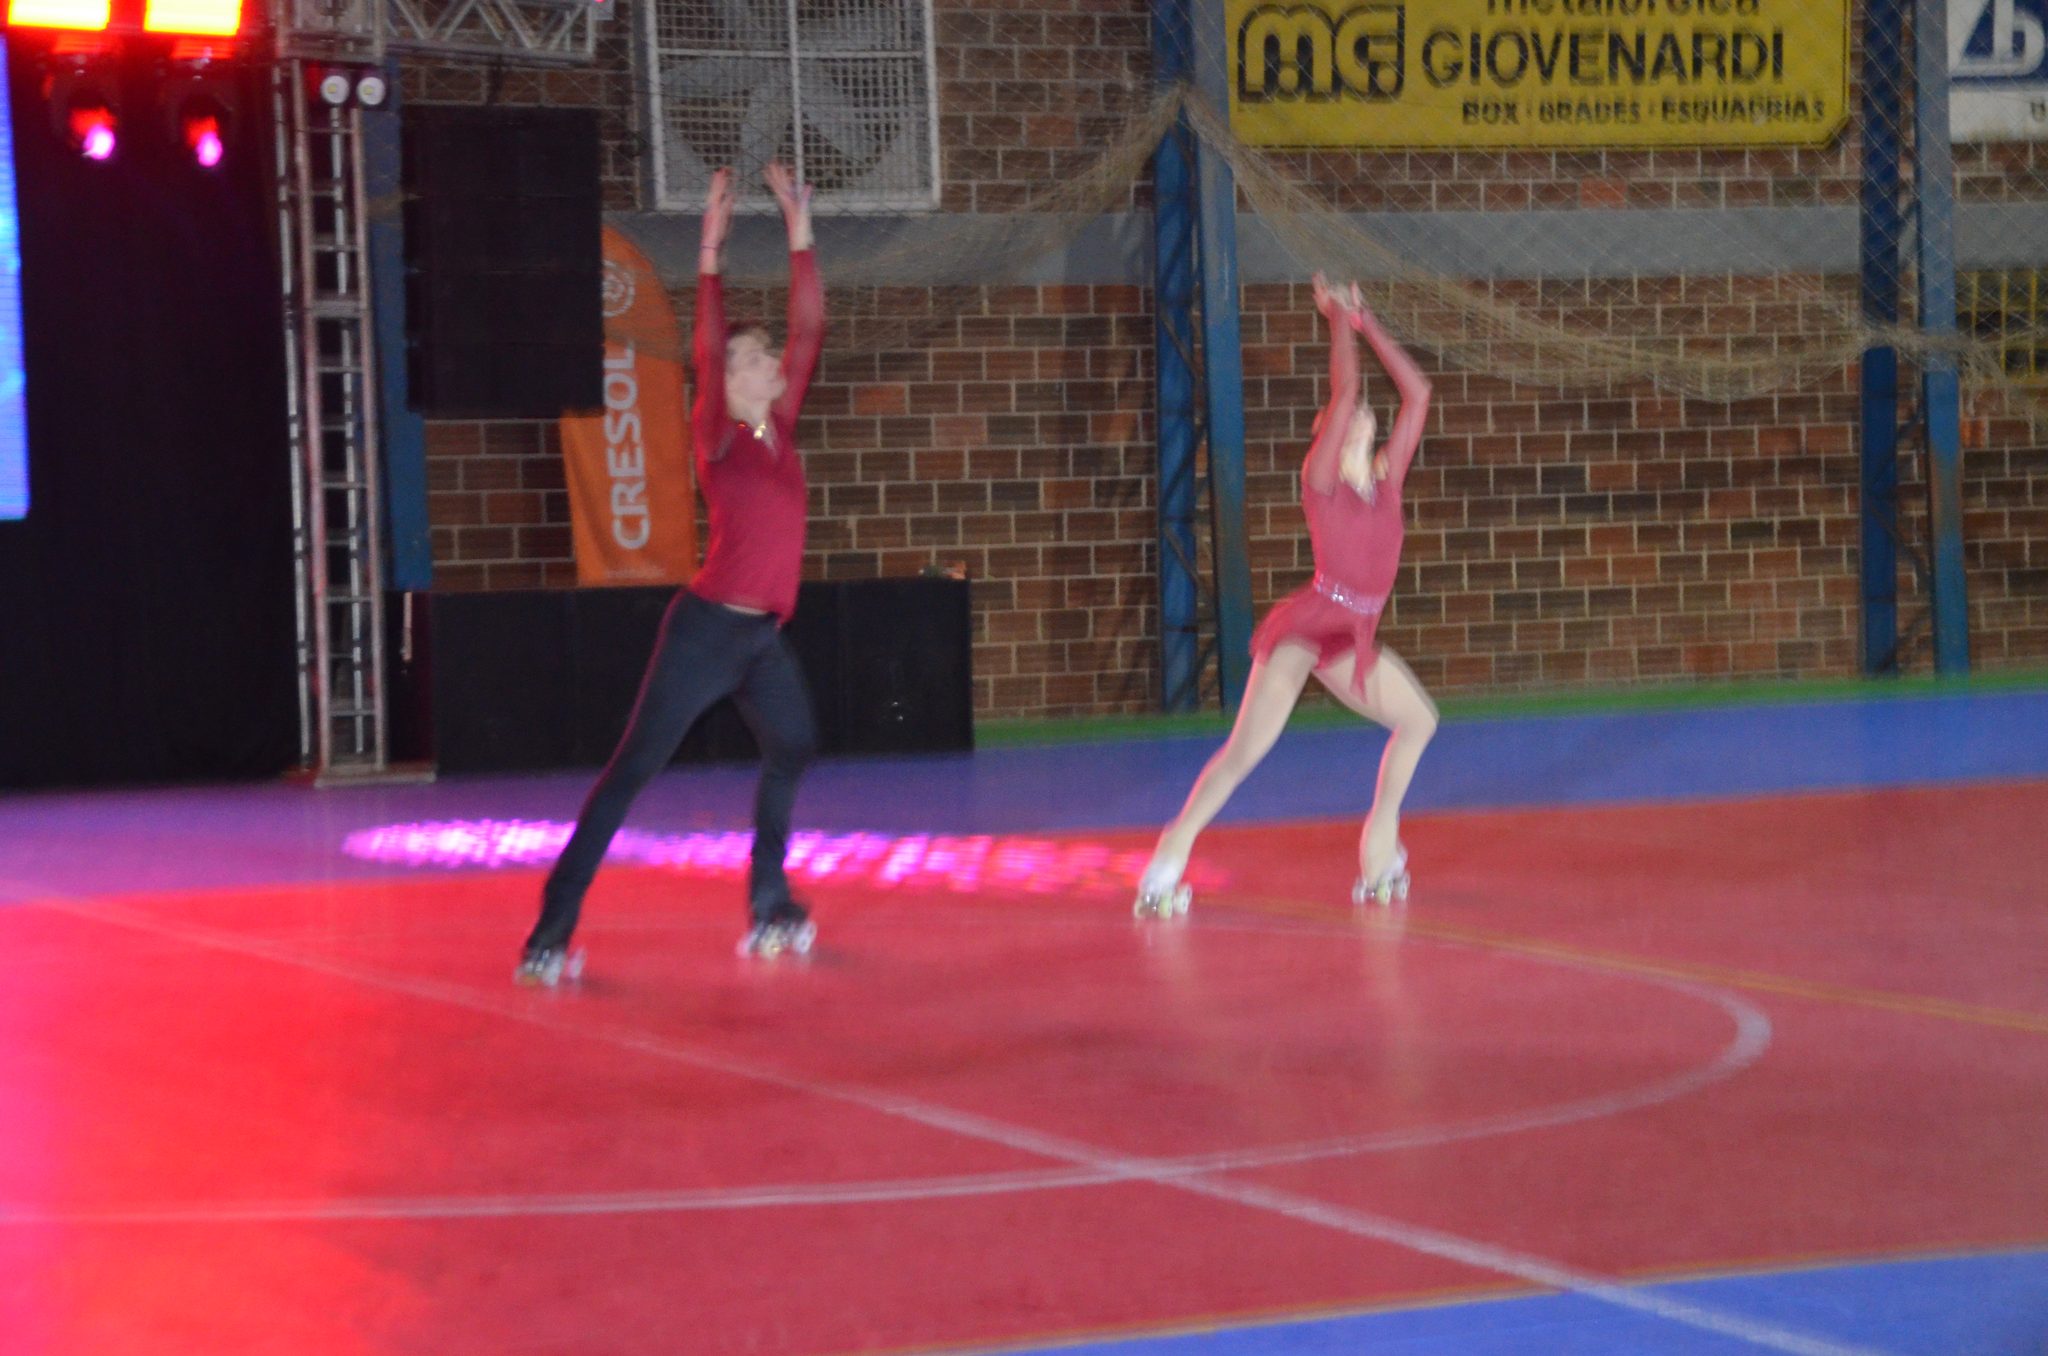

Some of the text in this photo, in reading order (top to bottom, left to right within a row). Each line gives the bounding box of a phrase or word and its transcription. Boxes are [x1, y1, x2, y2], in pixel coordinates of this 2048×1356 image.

[1421, 27, 1784, 87] GIOVENARDI
[1462, 95, 1825, 125] BOX GRADES ESQUADRIAS
[603, 341, 650, 550] CRESOL
